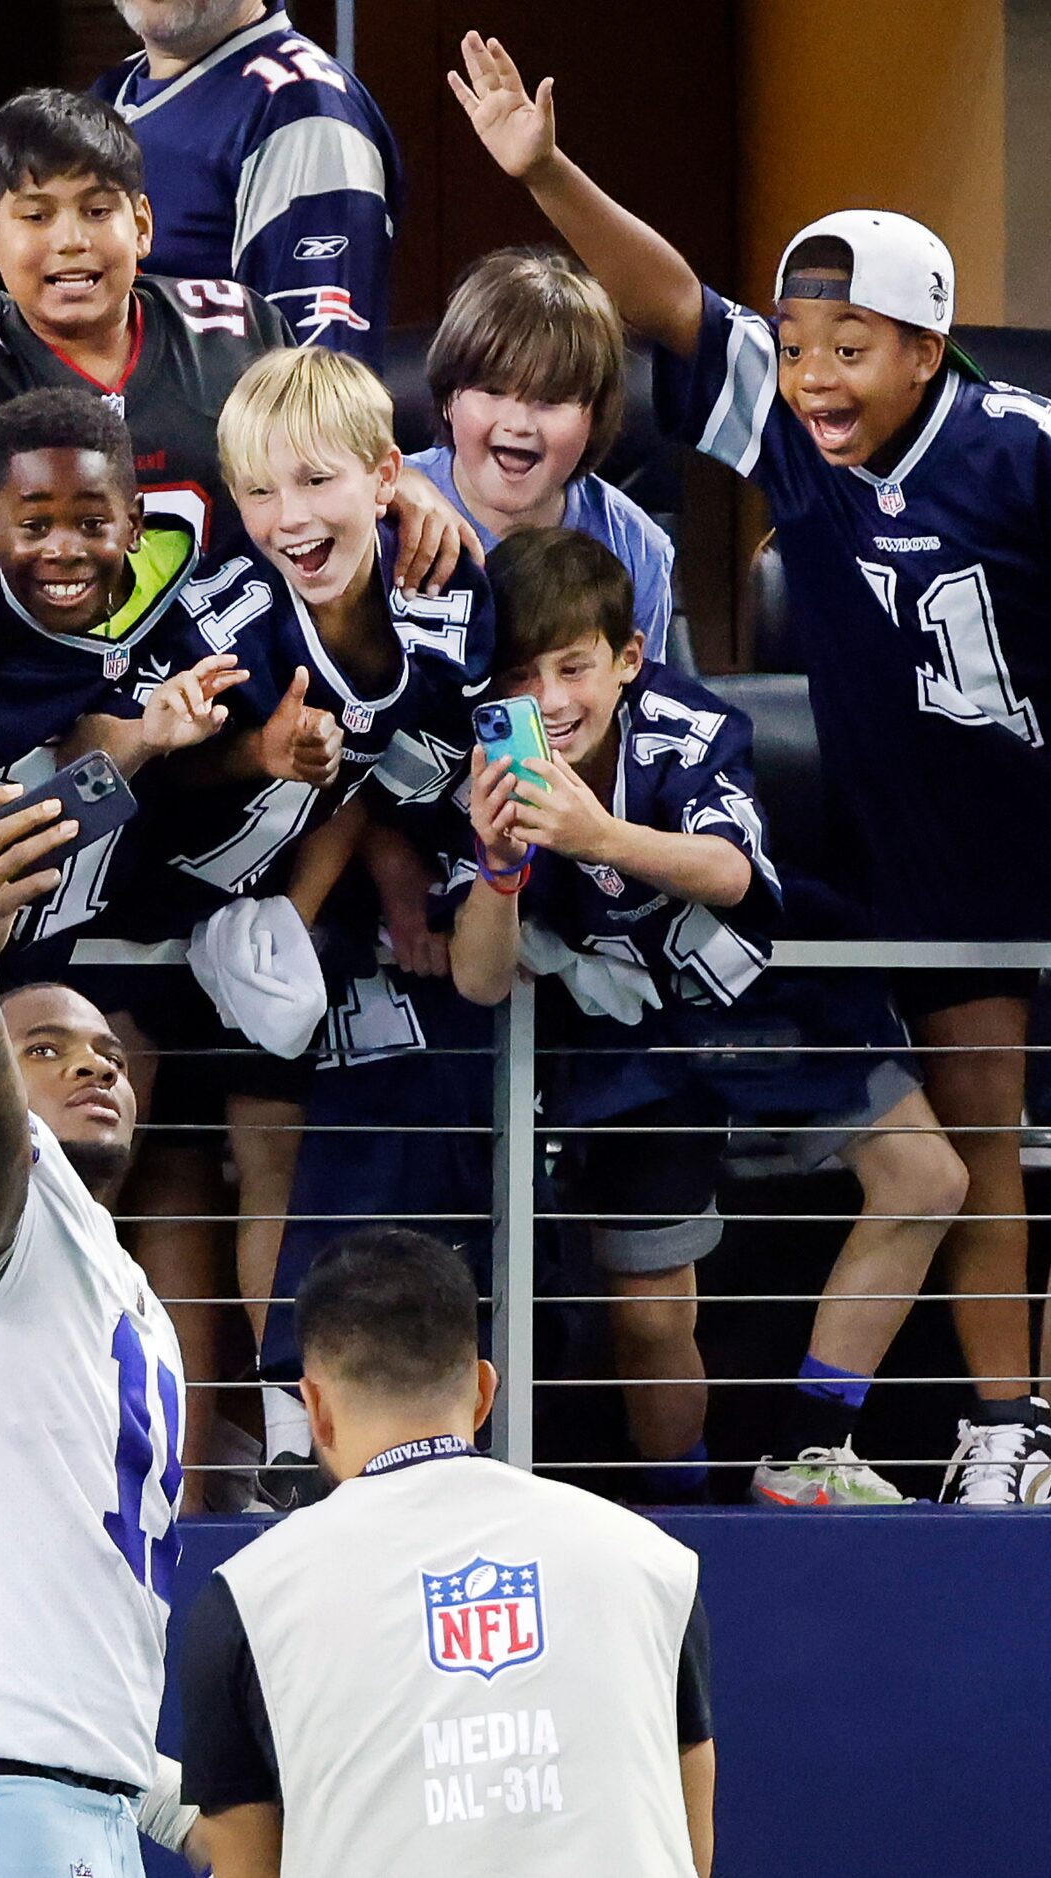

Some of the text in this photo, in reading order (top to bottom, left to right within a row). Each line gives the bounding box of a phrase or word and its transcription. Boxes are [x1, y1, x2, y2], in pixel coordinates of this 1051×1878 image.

[243, 39, 347, 94] 12
[176, 278, 245, 337] 12
[873, 536, 941, 552] OWBOYS
[178, 556, 274, 655] 11
[108, 659, 127, 677] NFL
[632, 690, 728, 770] 11
[365, 1439, 432, 1473] STADIUM
[438, 1601, 534, 1663] NFL
[423, 1709, 559, 1769] MEDIA
[424, 1764, 564, 1826] DAL-314
